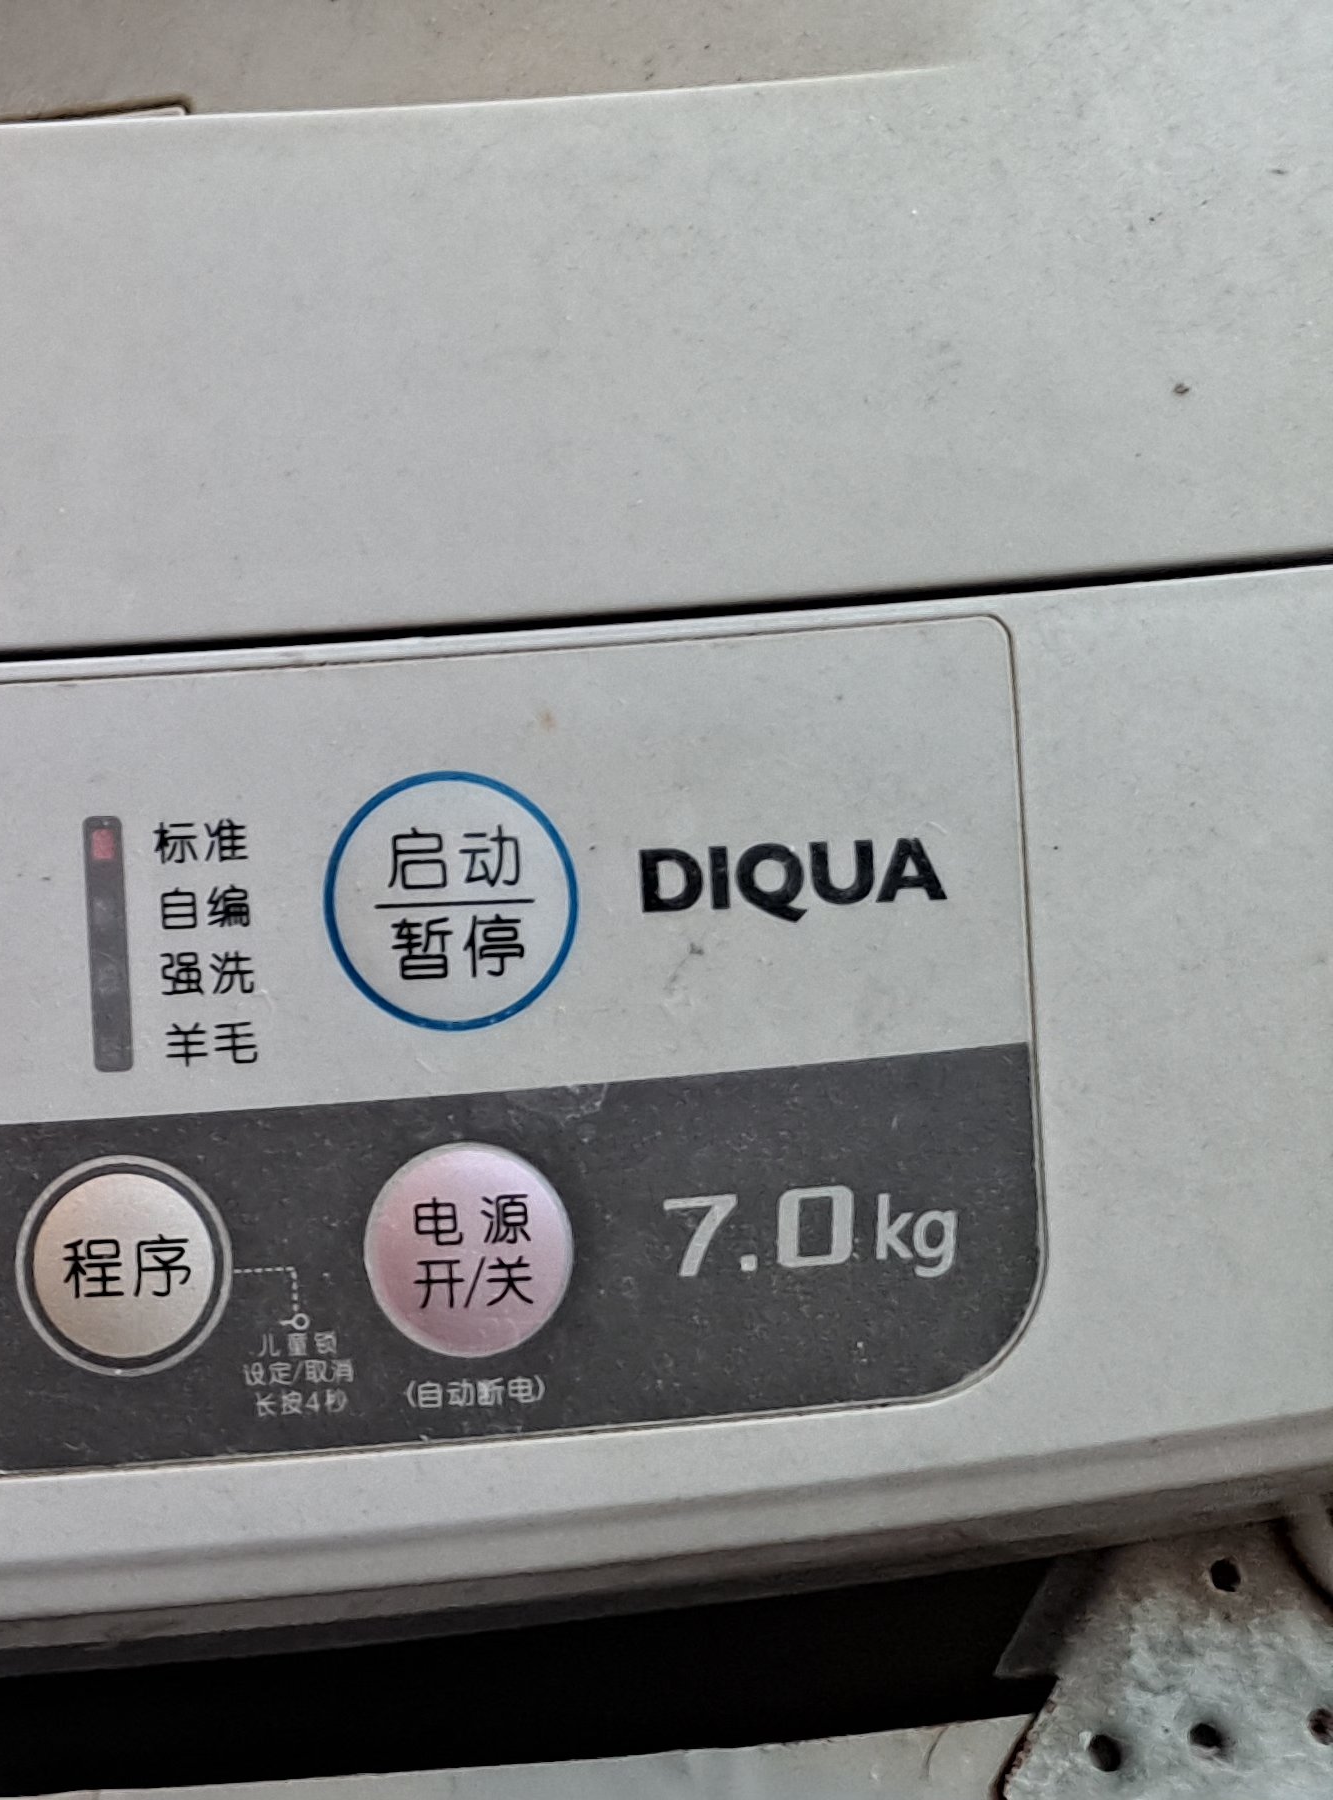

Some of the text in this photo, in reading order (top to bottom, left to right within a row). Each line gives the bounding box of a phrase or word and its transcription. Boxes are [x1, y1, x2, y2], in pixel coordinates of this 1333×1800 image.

[155, 820, 247, 863] 标准
[389, 826, 519, 889] 启动
[640, 838, 947, 922] DIQUA
[162, 886, 249, 929] 自编
[392, 914, 524, 980] 暂停
[161, 952, 253, 995] 强洗
[167, 1022, 257, 1066] 羊毛
[64, 1234, 191, 1298] 程序
[414, 1258, 533, 1309] 开/关
